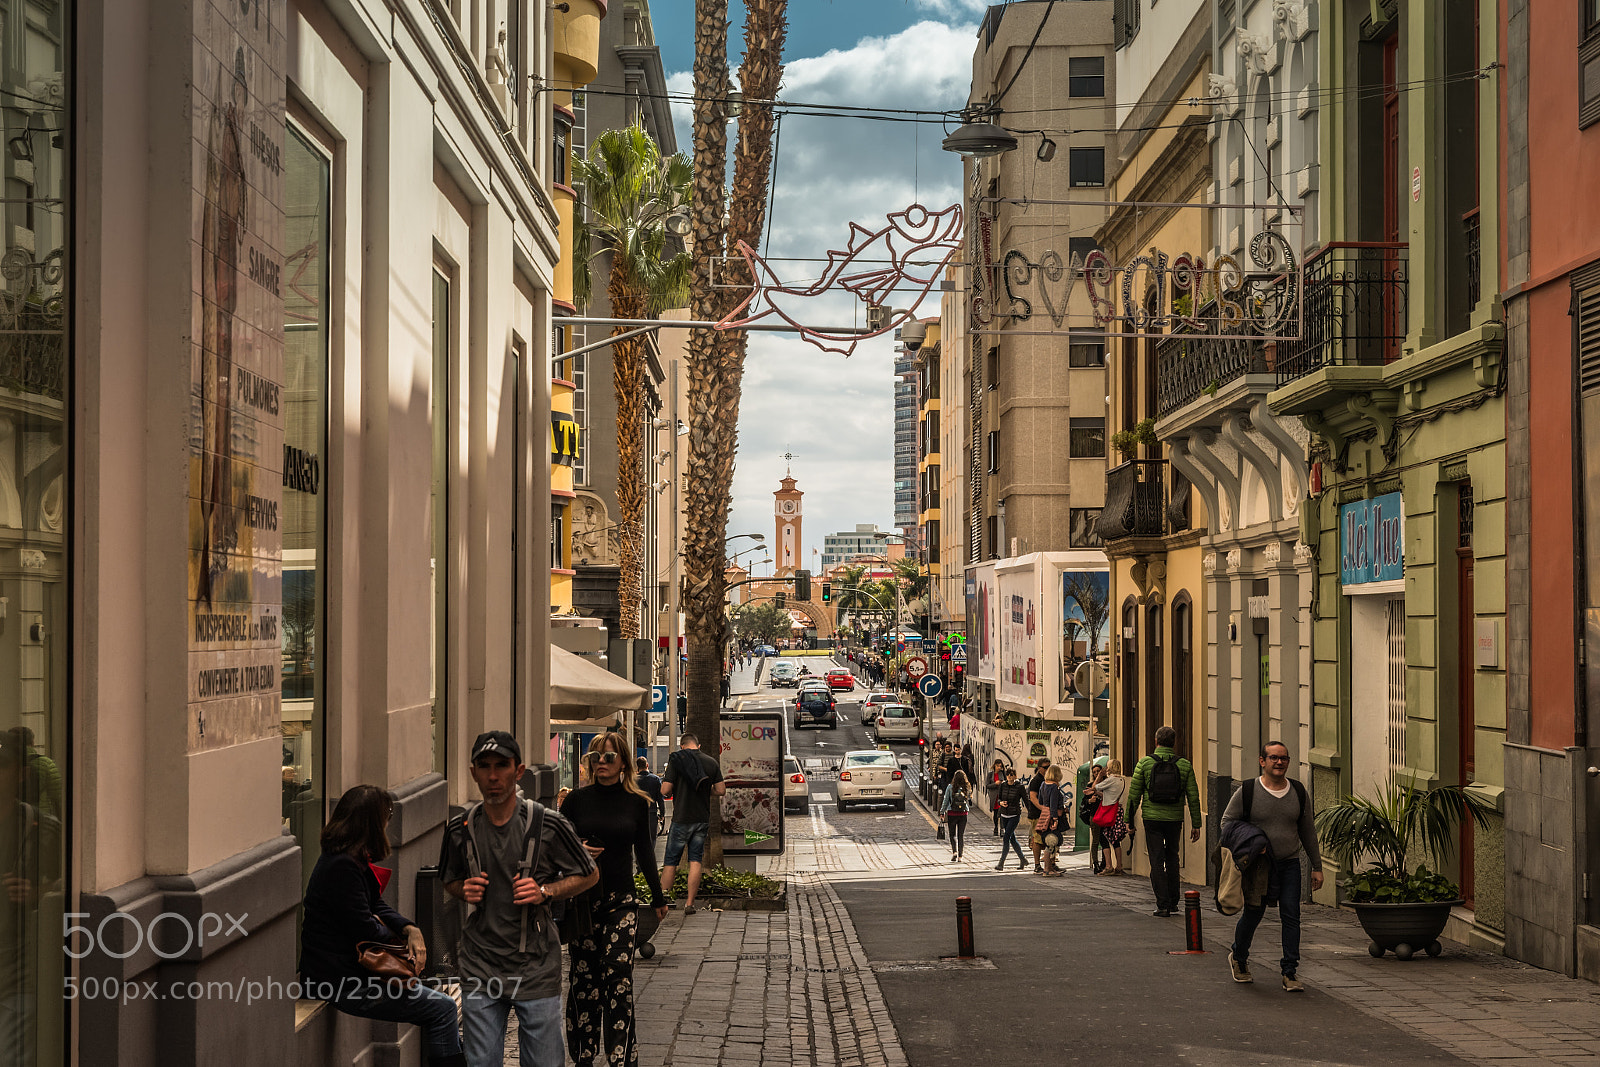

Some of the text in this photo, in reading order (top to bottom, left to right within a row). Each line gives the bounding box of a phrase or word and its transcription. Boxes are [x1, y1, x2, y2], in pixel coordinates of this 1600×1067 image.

[250, 121, 280, 177] HUESOS
[249, 246, 280, 297] SANGRE
[237, 367, 280, 416] PULMONES
[244, 494, 278, 531] NERVIOS
[195, 613, 247, 642] INDISPENSABLE
[198, 667, 239, 698] CONVENIENTE
[260, 664, 274, 690] EDAD
